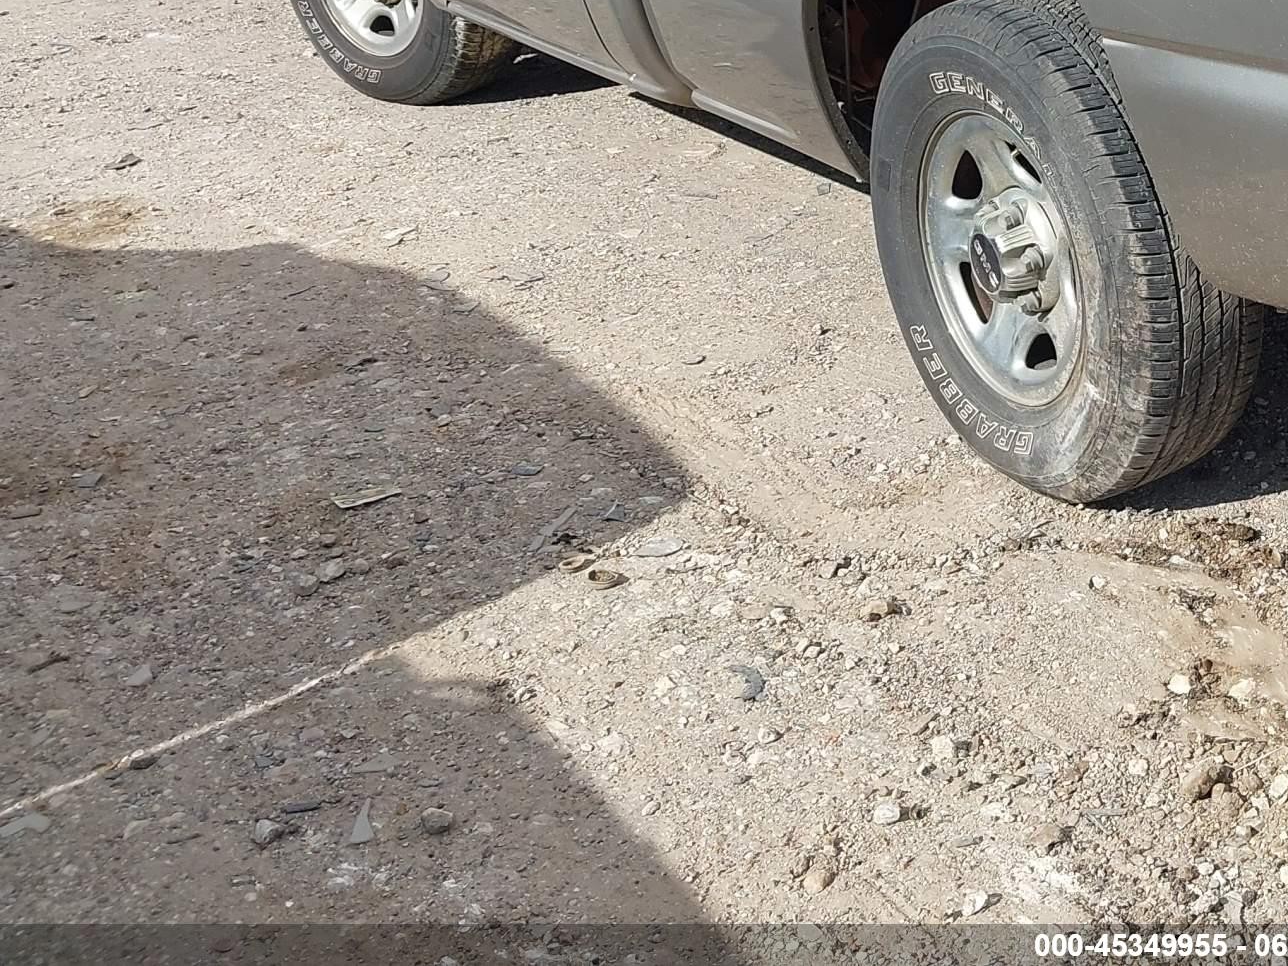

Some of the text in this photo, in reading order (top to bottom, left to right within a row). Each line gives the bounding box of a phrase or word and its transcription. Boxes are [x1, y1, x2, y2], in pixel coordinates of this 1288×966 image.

[298, 1, 382, 84] GRABBER
[974, 239, 1000, 288] GMC
[910, 325, 1034, 455] GRABBER
